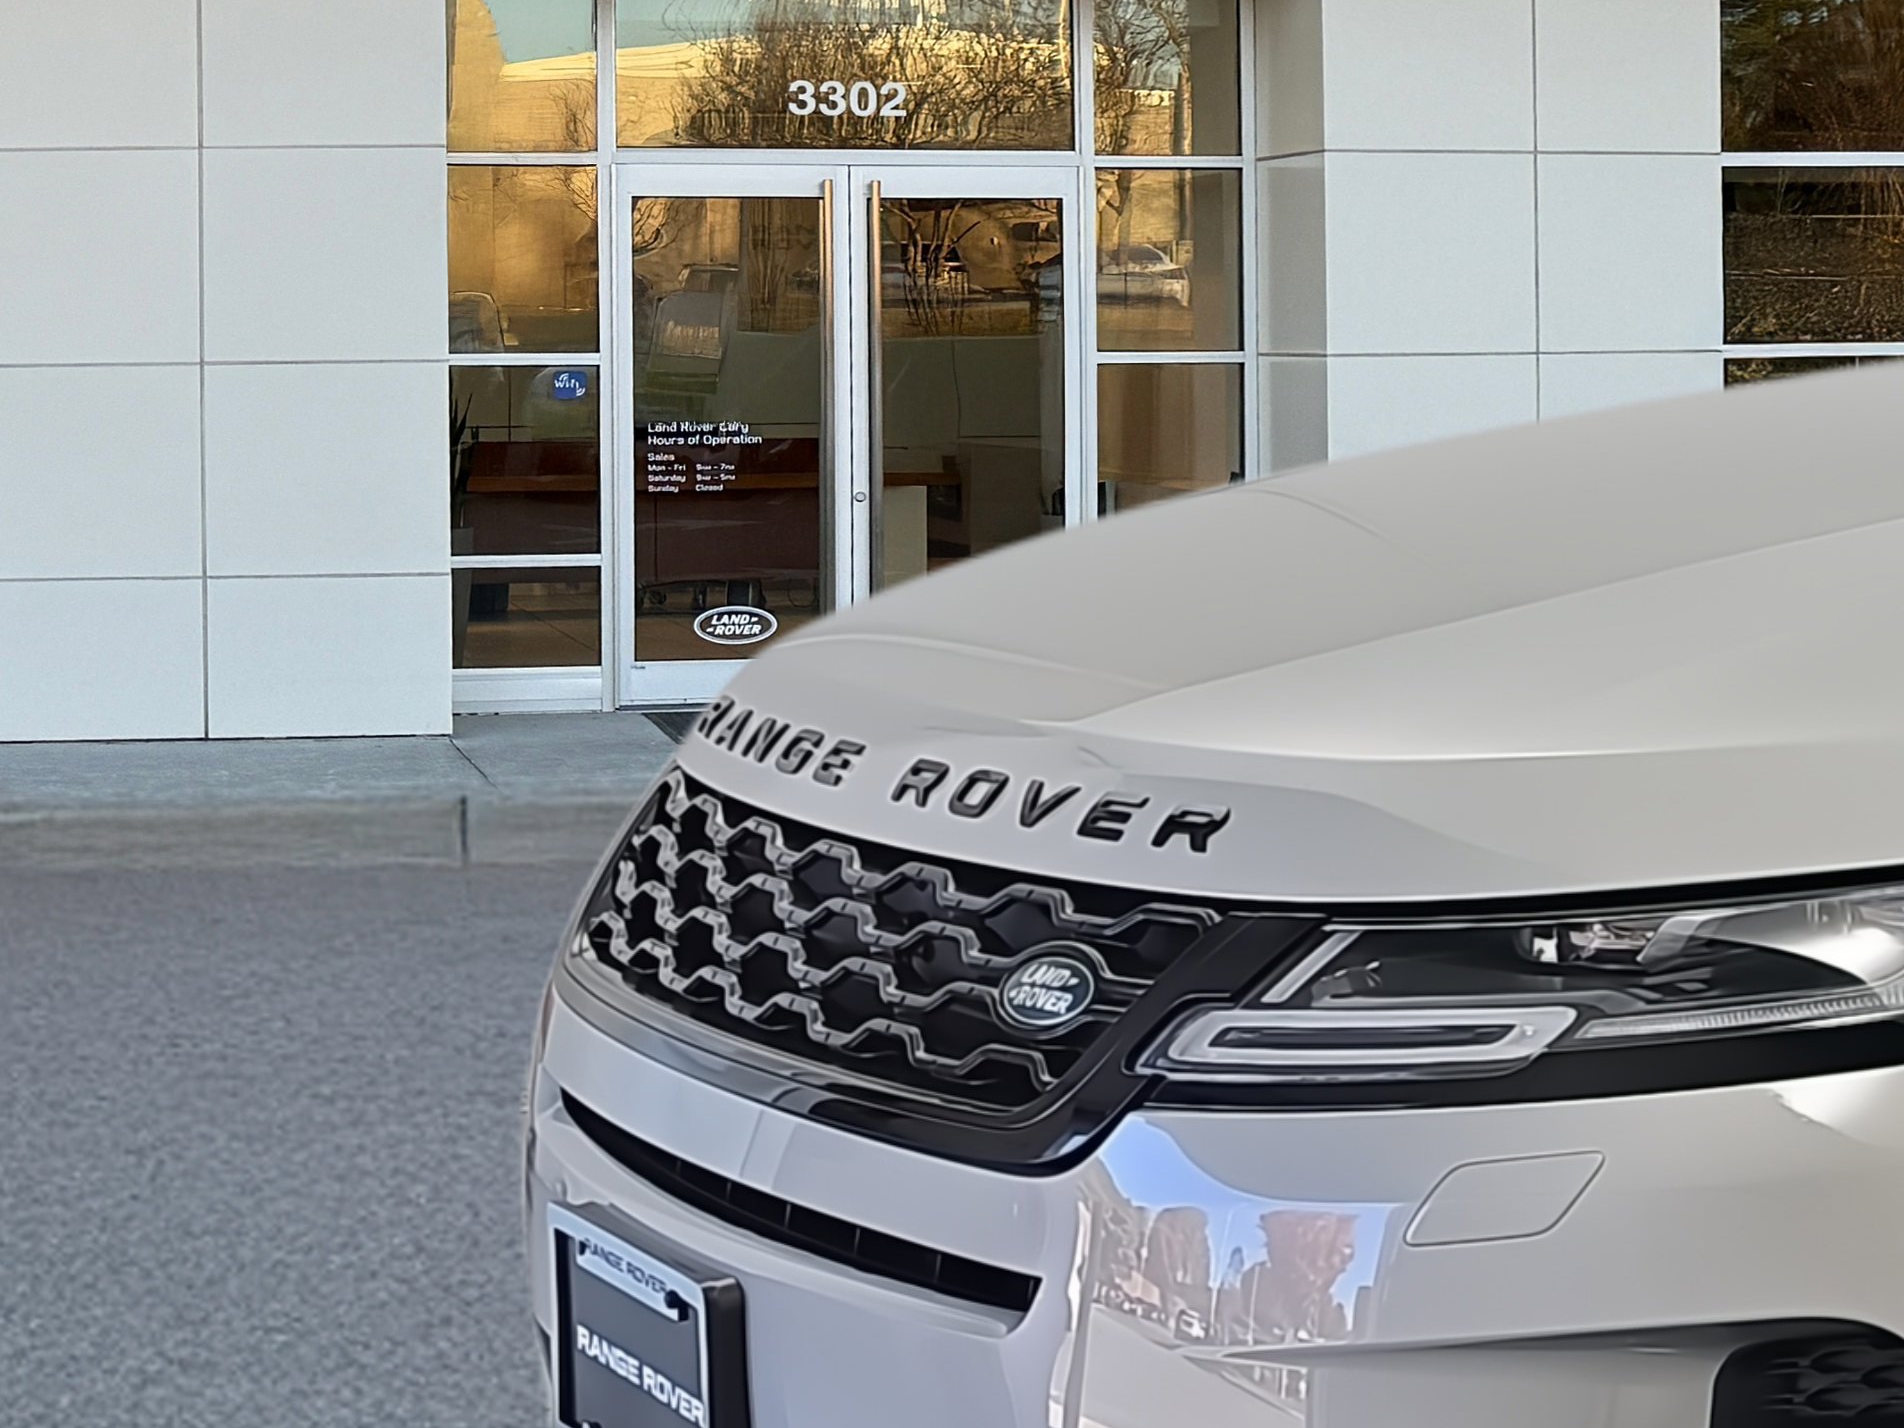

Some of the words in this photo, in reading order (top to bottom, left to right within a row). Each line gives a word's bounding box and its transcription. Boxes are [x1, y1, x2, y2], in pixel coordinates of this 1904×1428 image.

[787, 79, 908, 118] 3302
[647, 435, 685, 446] Hours
[687, 434, 700, 445] of
[702, 434, 763, 447] Operation
[711, 614, 750, 625] LAND
[714, 624, 762, 635] ROVER
[698, 695, 867, 787] RANGE
[891, 758, 1233, 854] ROVER
[1012, 985, 1073, 1014] ROVER
[576, 1324, 641, 1386] RANGE
[642, 1364, 705, 1428] ROVER
